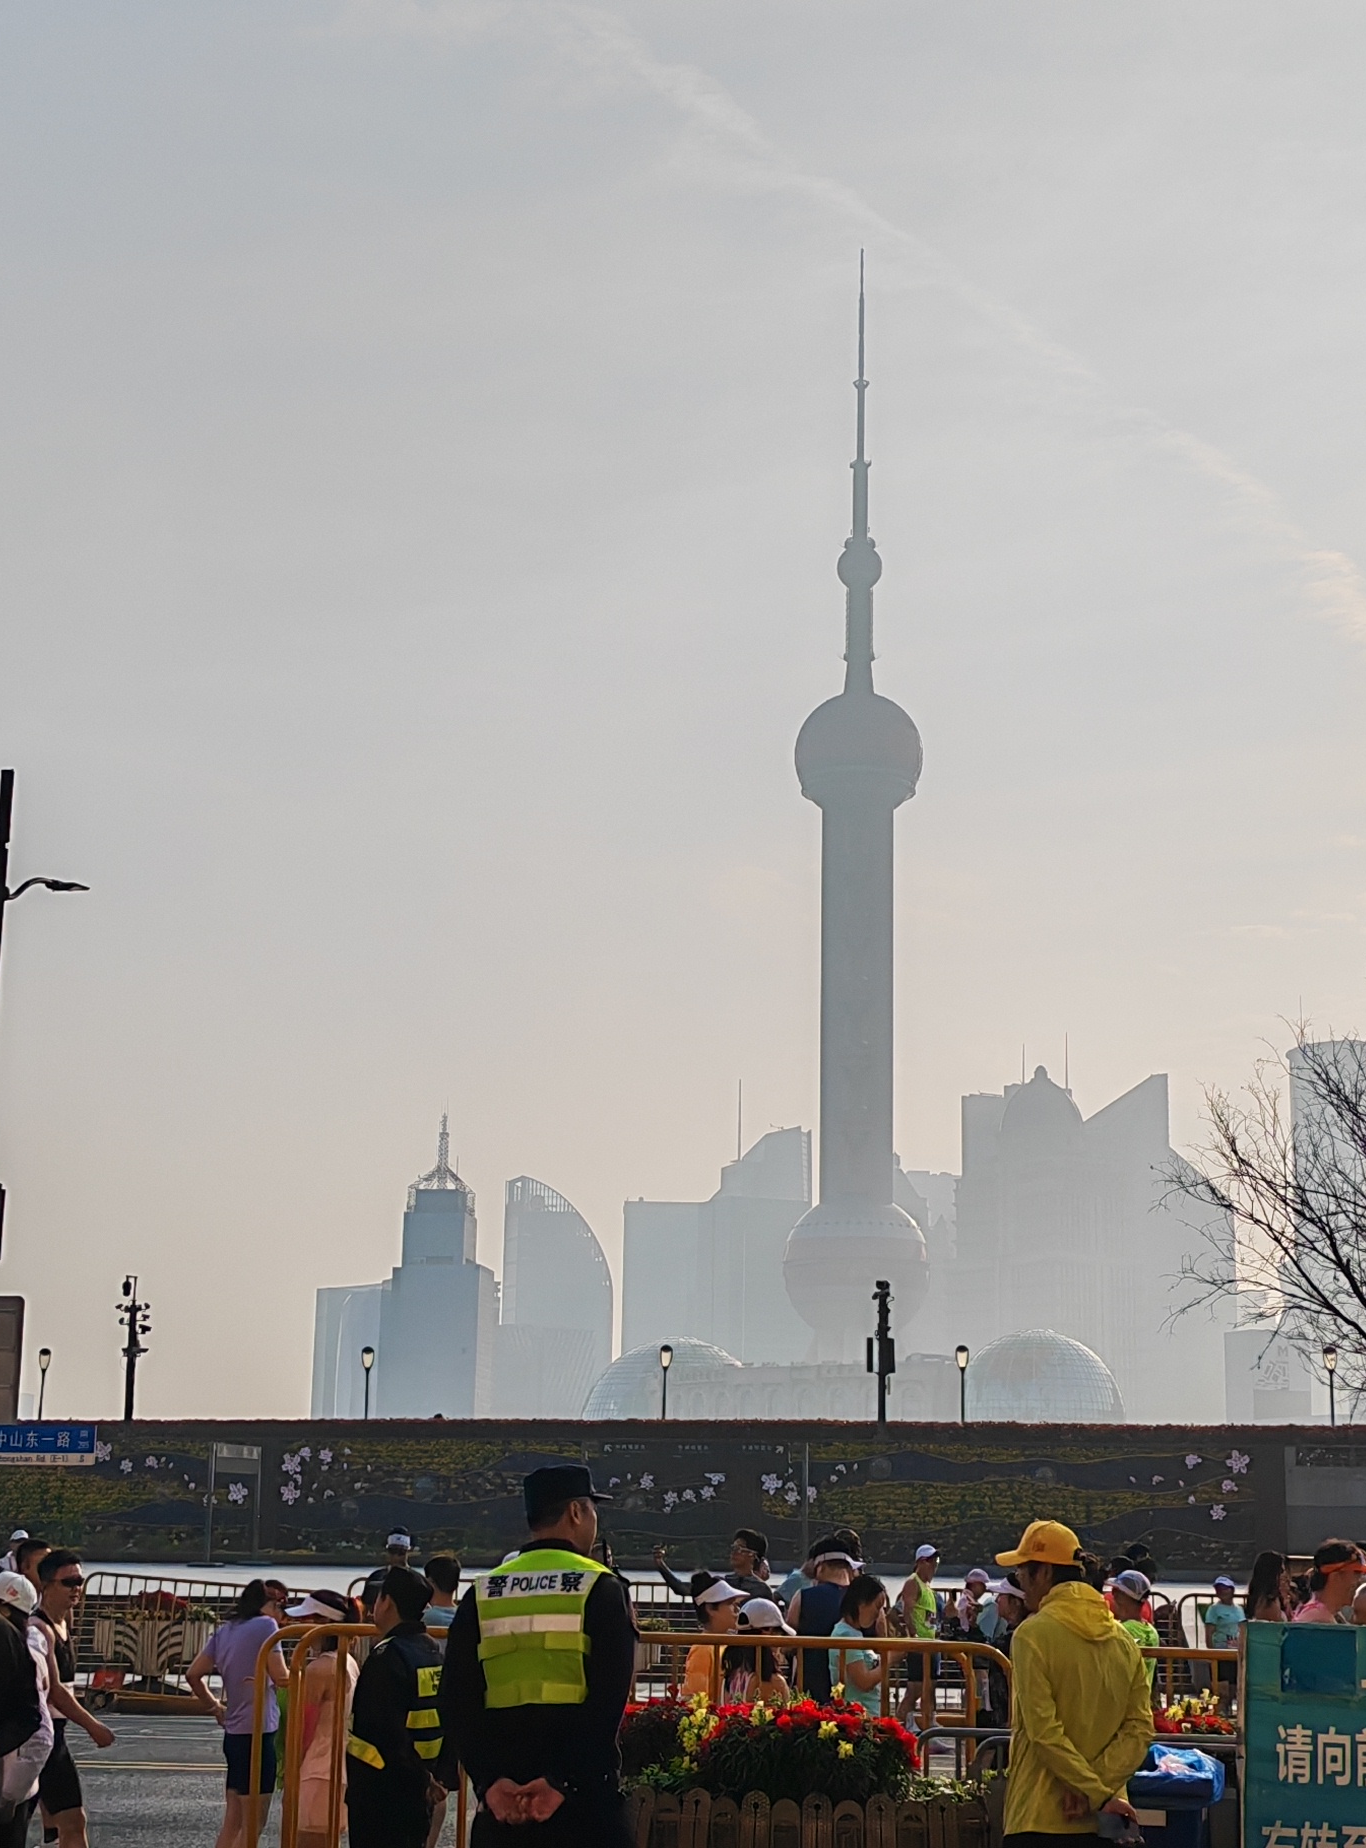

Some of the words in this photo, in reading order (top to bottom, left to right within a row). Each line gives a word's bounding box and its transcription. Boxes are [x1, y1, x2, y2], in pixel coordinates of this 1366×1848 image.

[487, 1575, 510, 1598] 警
[510, 1575, 557, 1592] POLICE
[560, 1572, 585, 1592] 察
